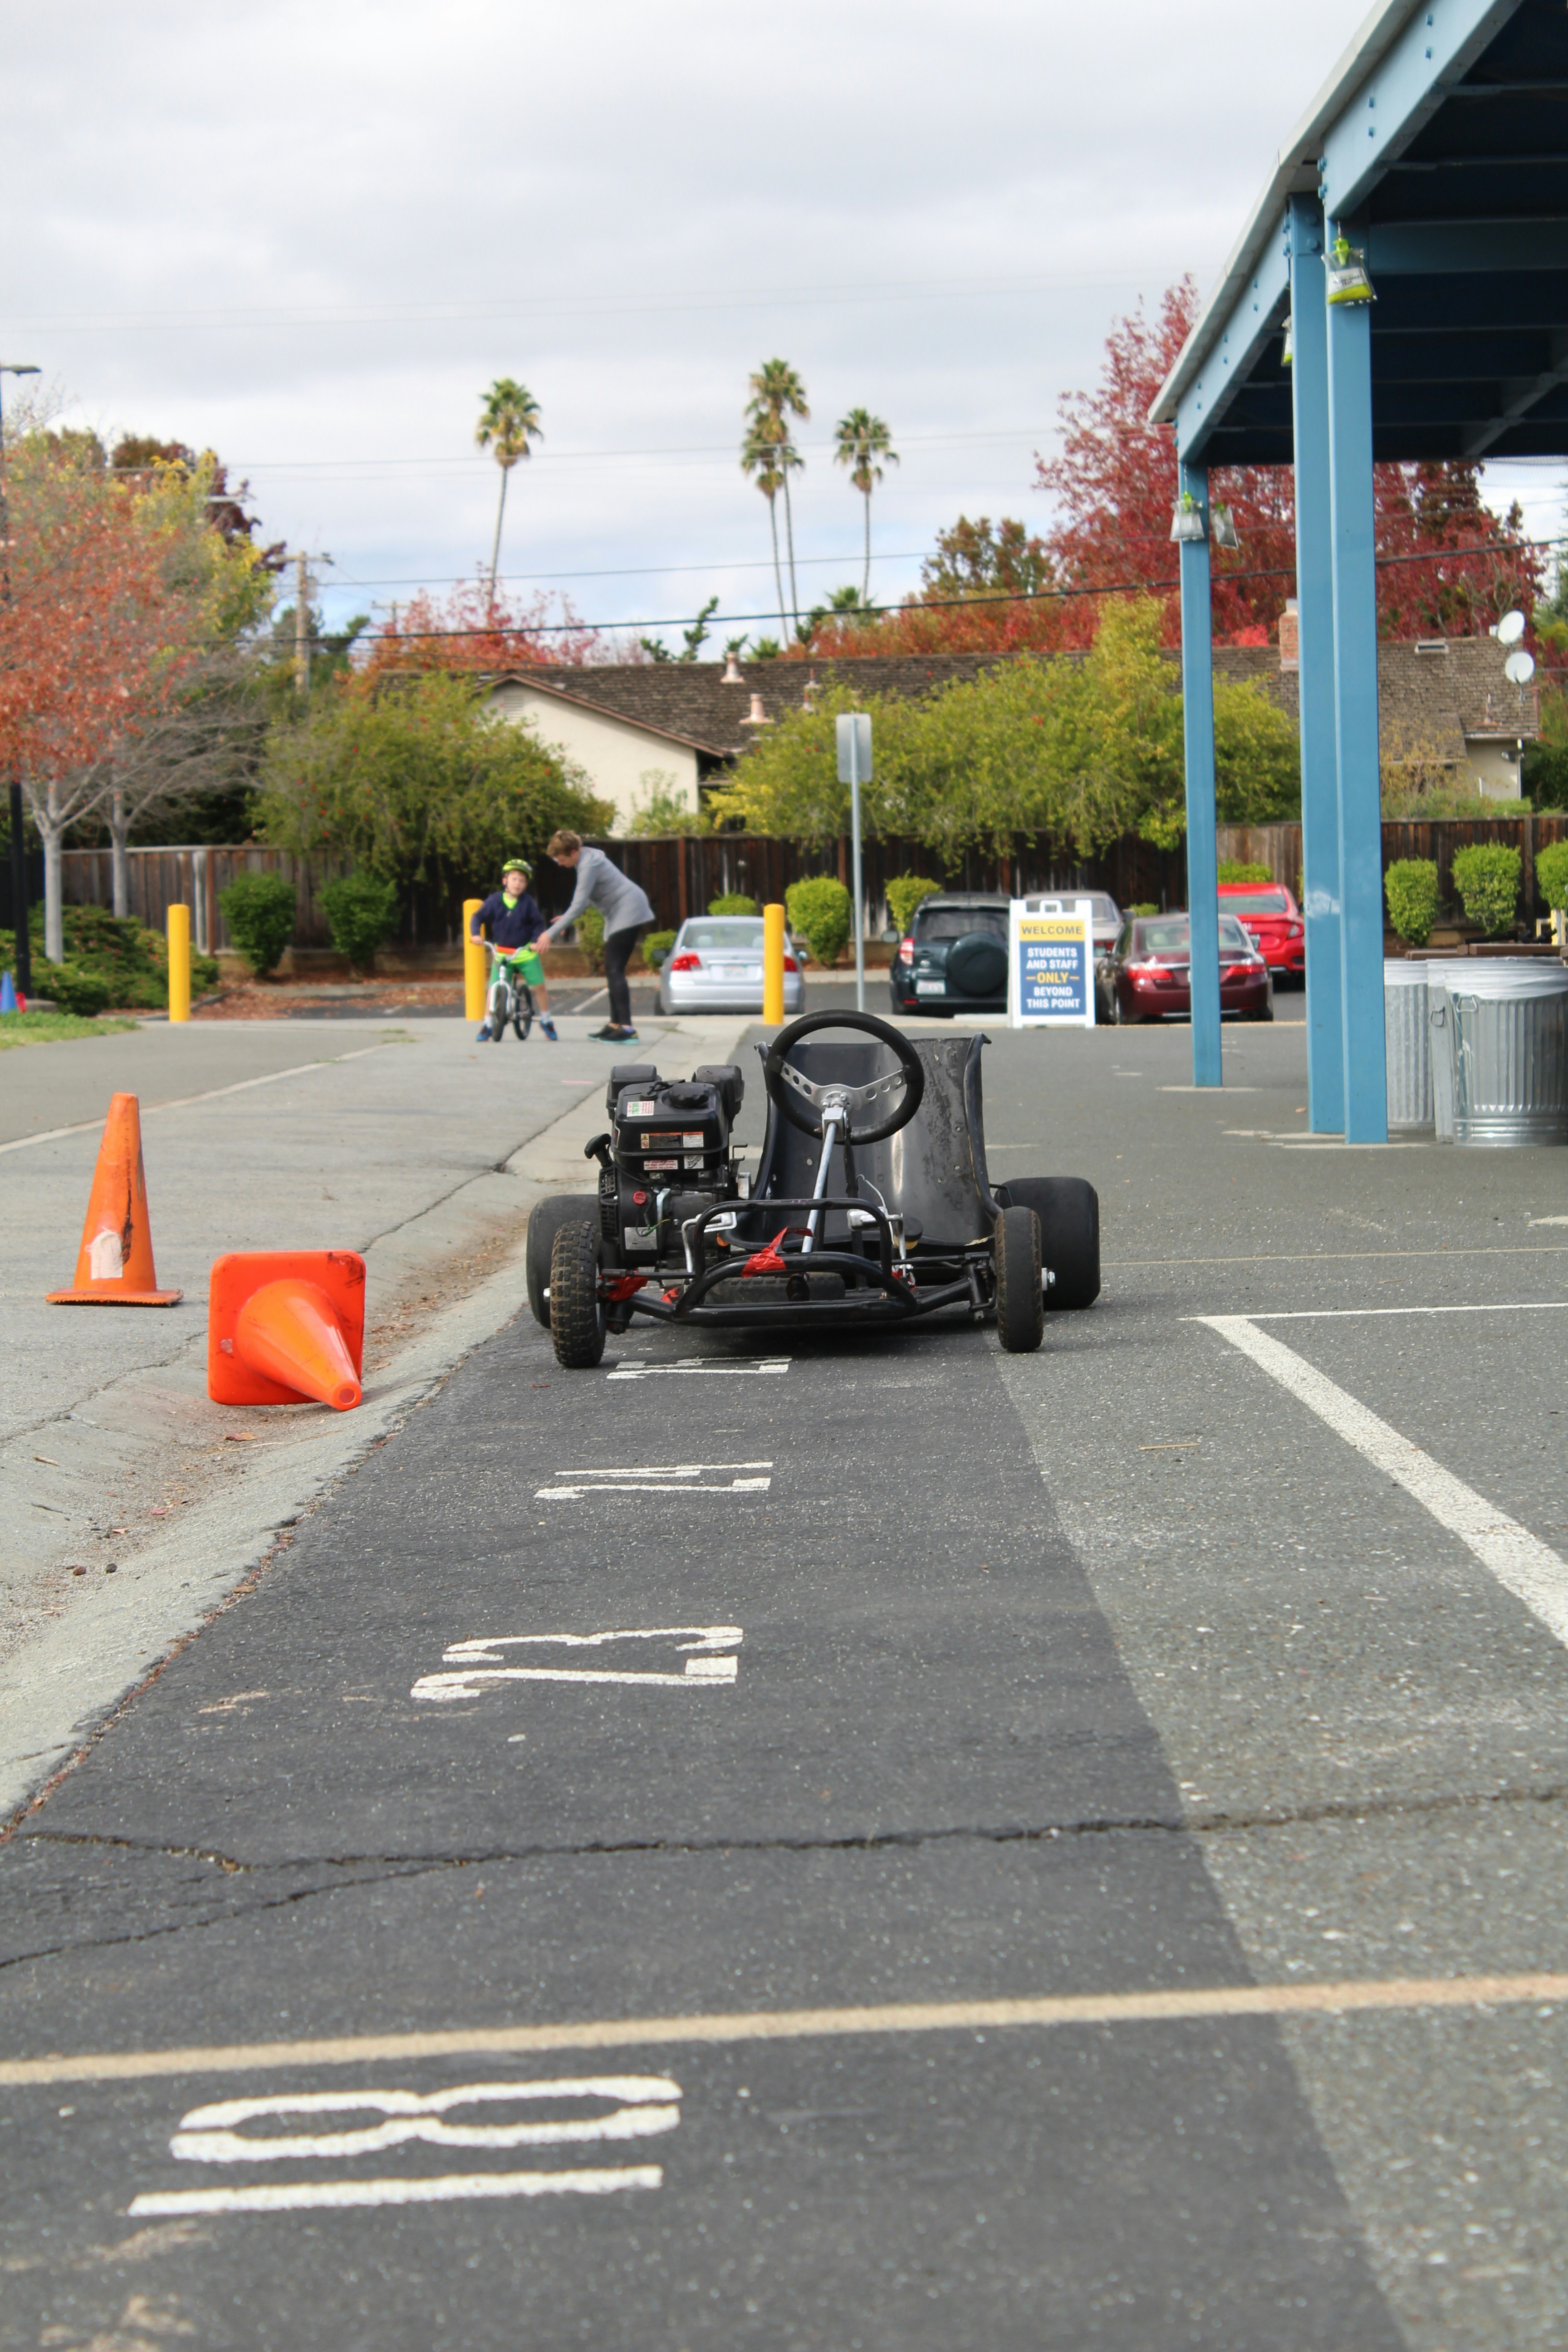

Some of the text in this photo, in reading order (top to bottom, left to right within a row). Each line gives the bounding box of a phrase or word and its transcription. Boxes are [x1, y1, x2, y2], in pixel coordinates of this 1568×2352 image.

[1022, 926, 1082, 935] WELCOME
[1027, 947, 1077, 957] STUDENTS
[1026, 960, 1078, 970] AND STAFF
[1037, 972, 1069, 984] ONLY
[1034, 986, 1073, 996] BEYOND
[1026, 999, 1080, 1009] THIS POINT
[410, 1626, 744, 1702] 23
[128, 2076, 682, 2216] 18
